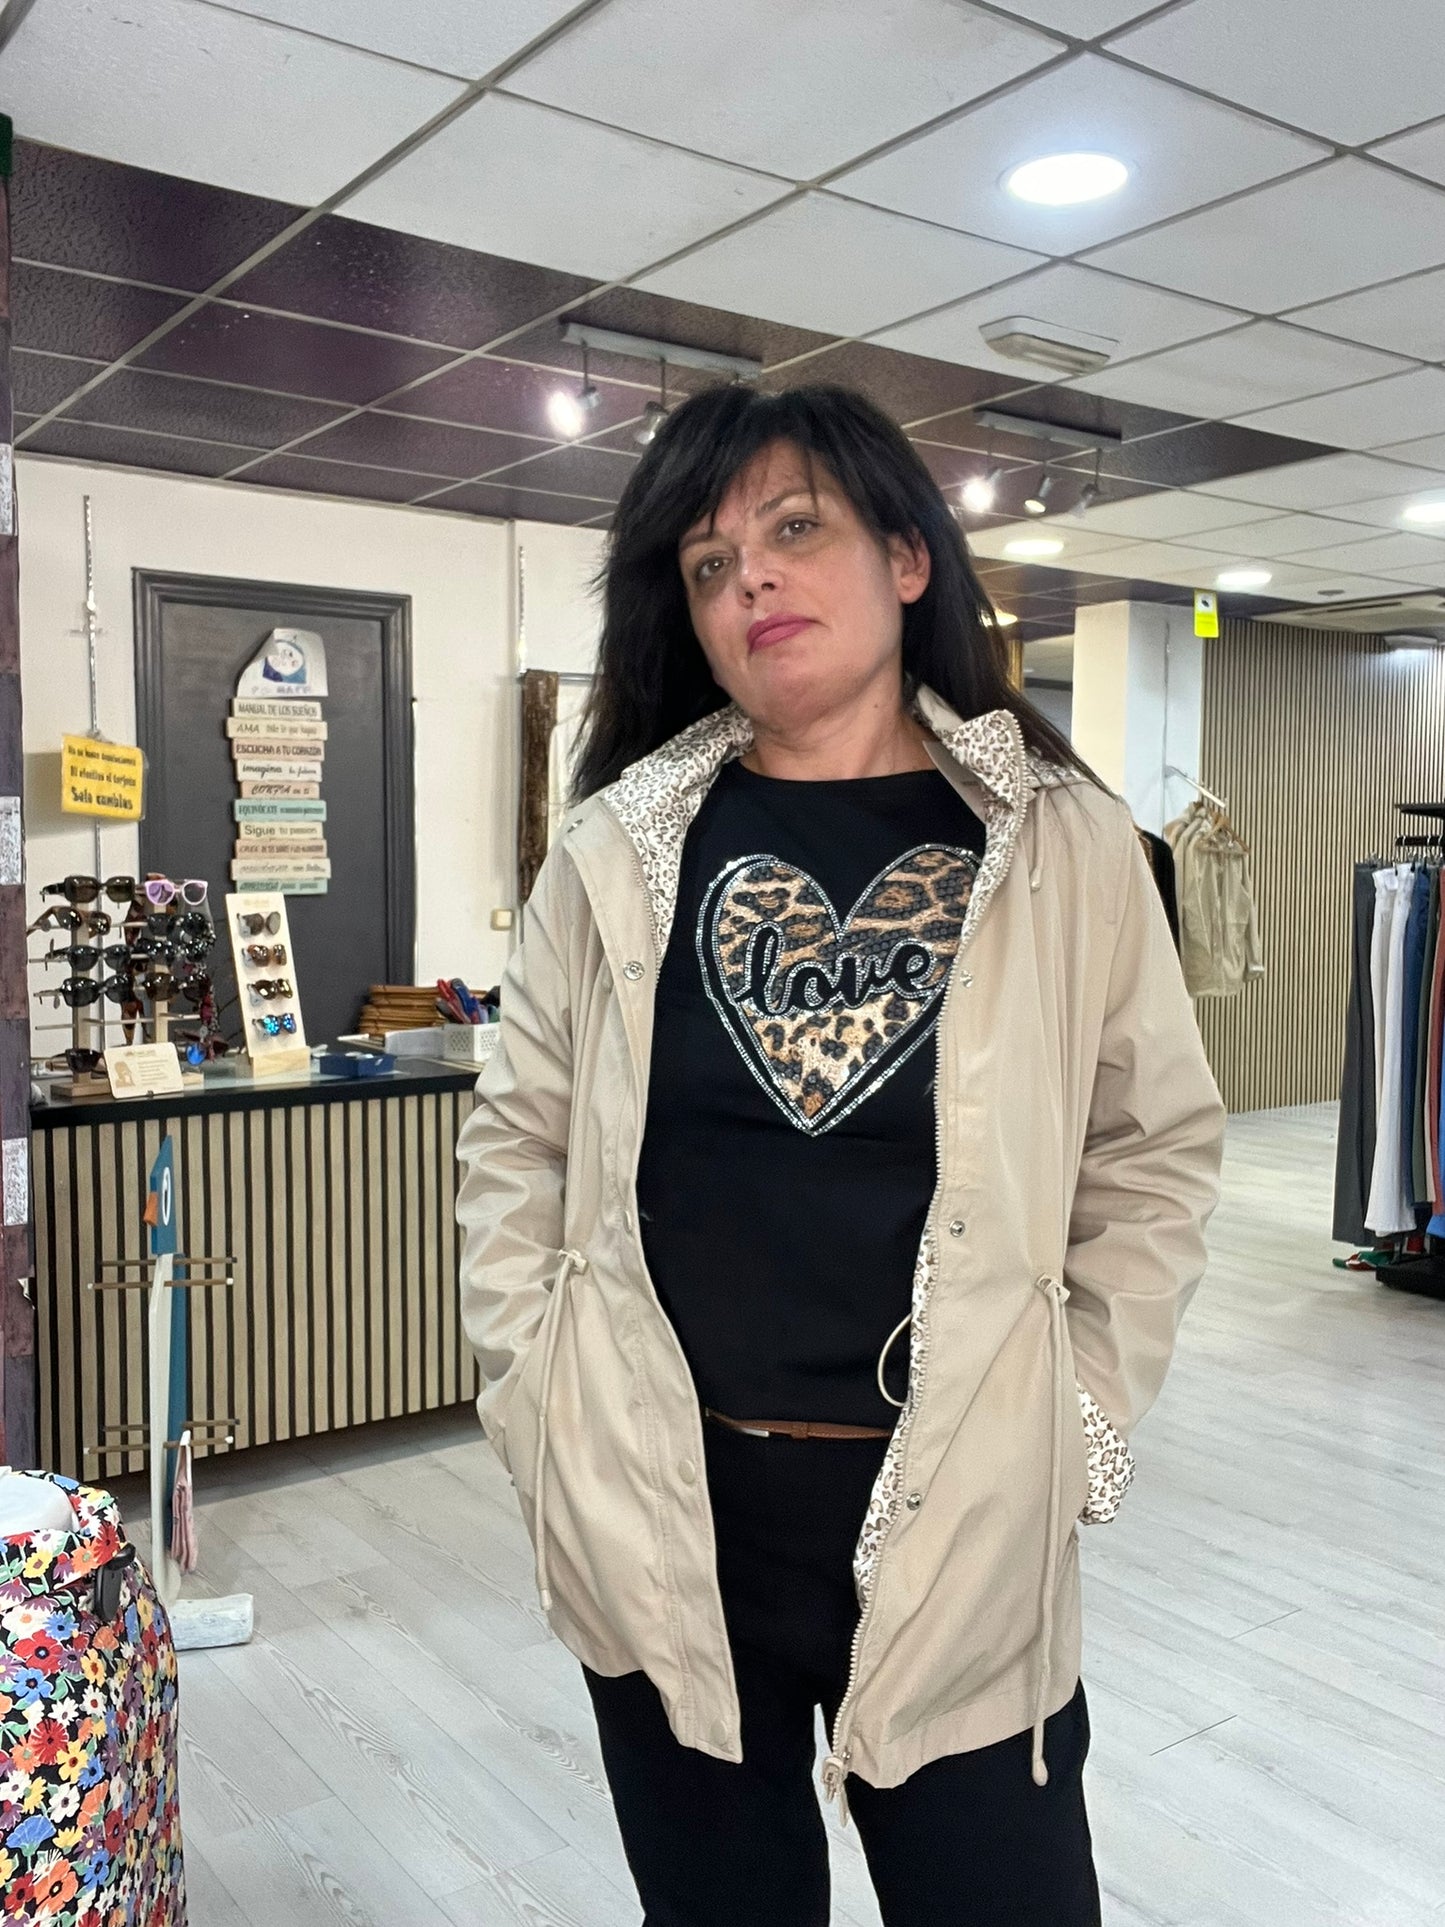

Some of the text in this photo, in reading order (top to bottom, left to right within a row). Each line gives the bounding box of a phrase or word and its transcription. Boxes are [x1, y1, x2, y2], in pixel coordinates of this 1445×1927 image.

[236, 724, 259, 733] AMA
[236, 744, 274, 754] ESCUCHA
[244, 825, 276, 837] Sigue
[733, 921, 937, 1019] love
